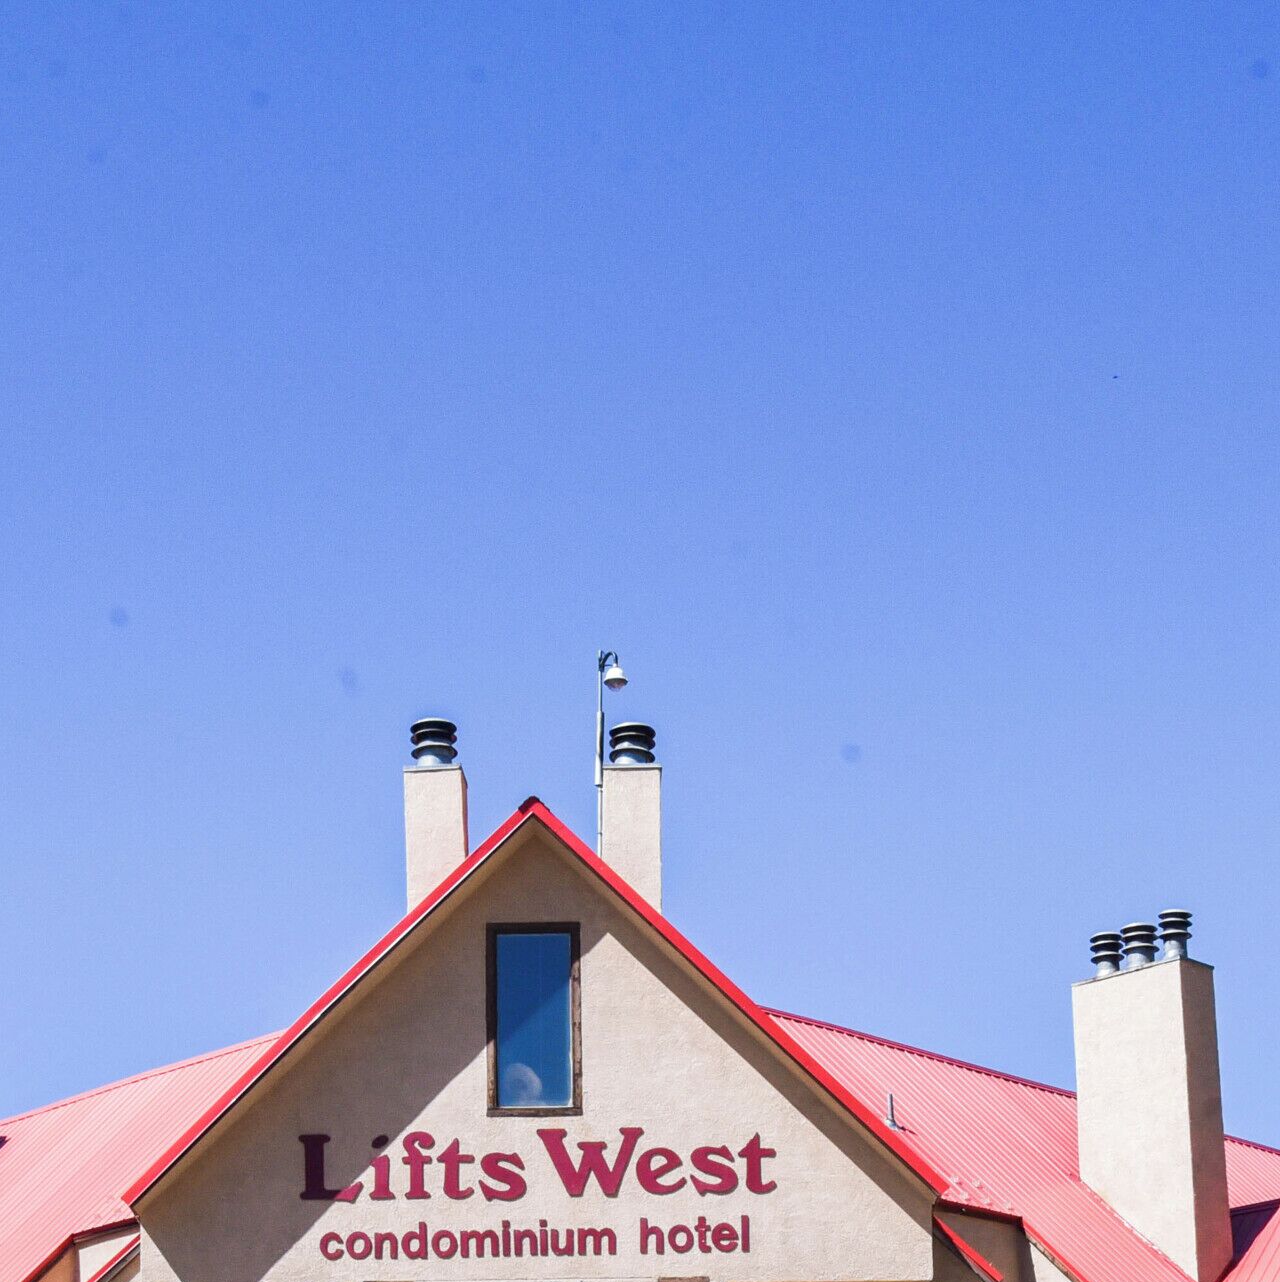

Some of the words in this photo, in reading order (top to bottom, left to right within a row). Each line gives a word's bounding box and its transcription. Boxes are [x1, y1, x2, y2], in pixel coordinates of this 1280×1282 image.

[298, 1131, 527, 1203] Lifts
[536, 1127, 777, 1198] West
[320, 1219, 617, 1261] condominium
[640, 1215, 750, 1255] hotel
